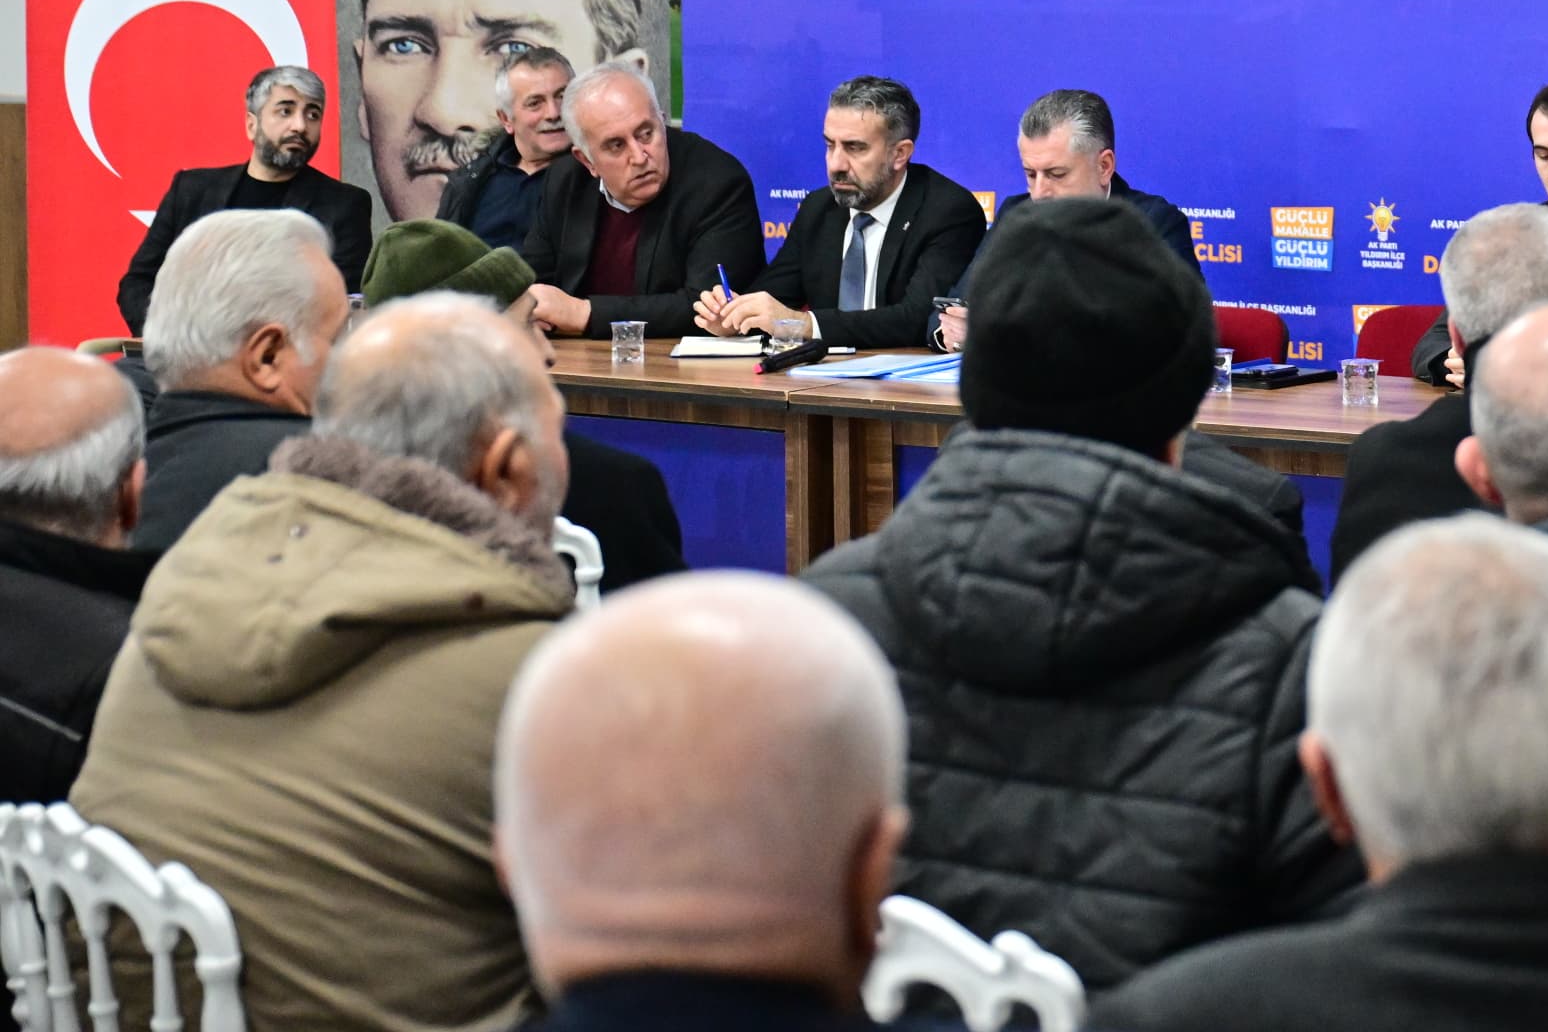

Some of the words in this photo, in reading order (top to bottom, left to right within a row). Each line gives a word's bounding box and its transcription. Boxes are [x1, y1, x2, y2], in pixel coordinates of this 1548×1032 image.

[1275, 209, 1328, 226] GÜÇLÜ
[1430, 218, 1445, 229] AK
[1275, 225, 1329, 238] MAHALLE
[1275, 239, 1328, 257] GÜÇLÜ
[1275, 255, 1328, 269] YILDIRIM
